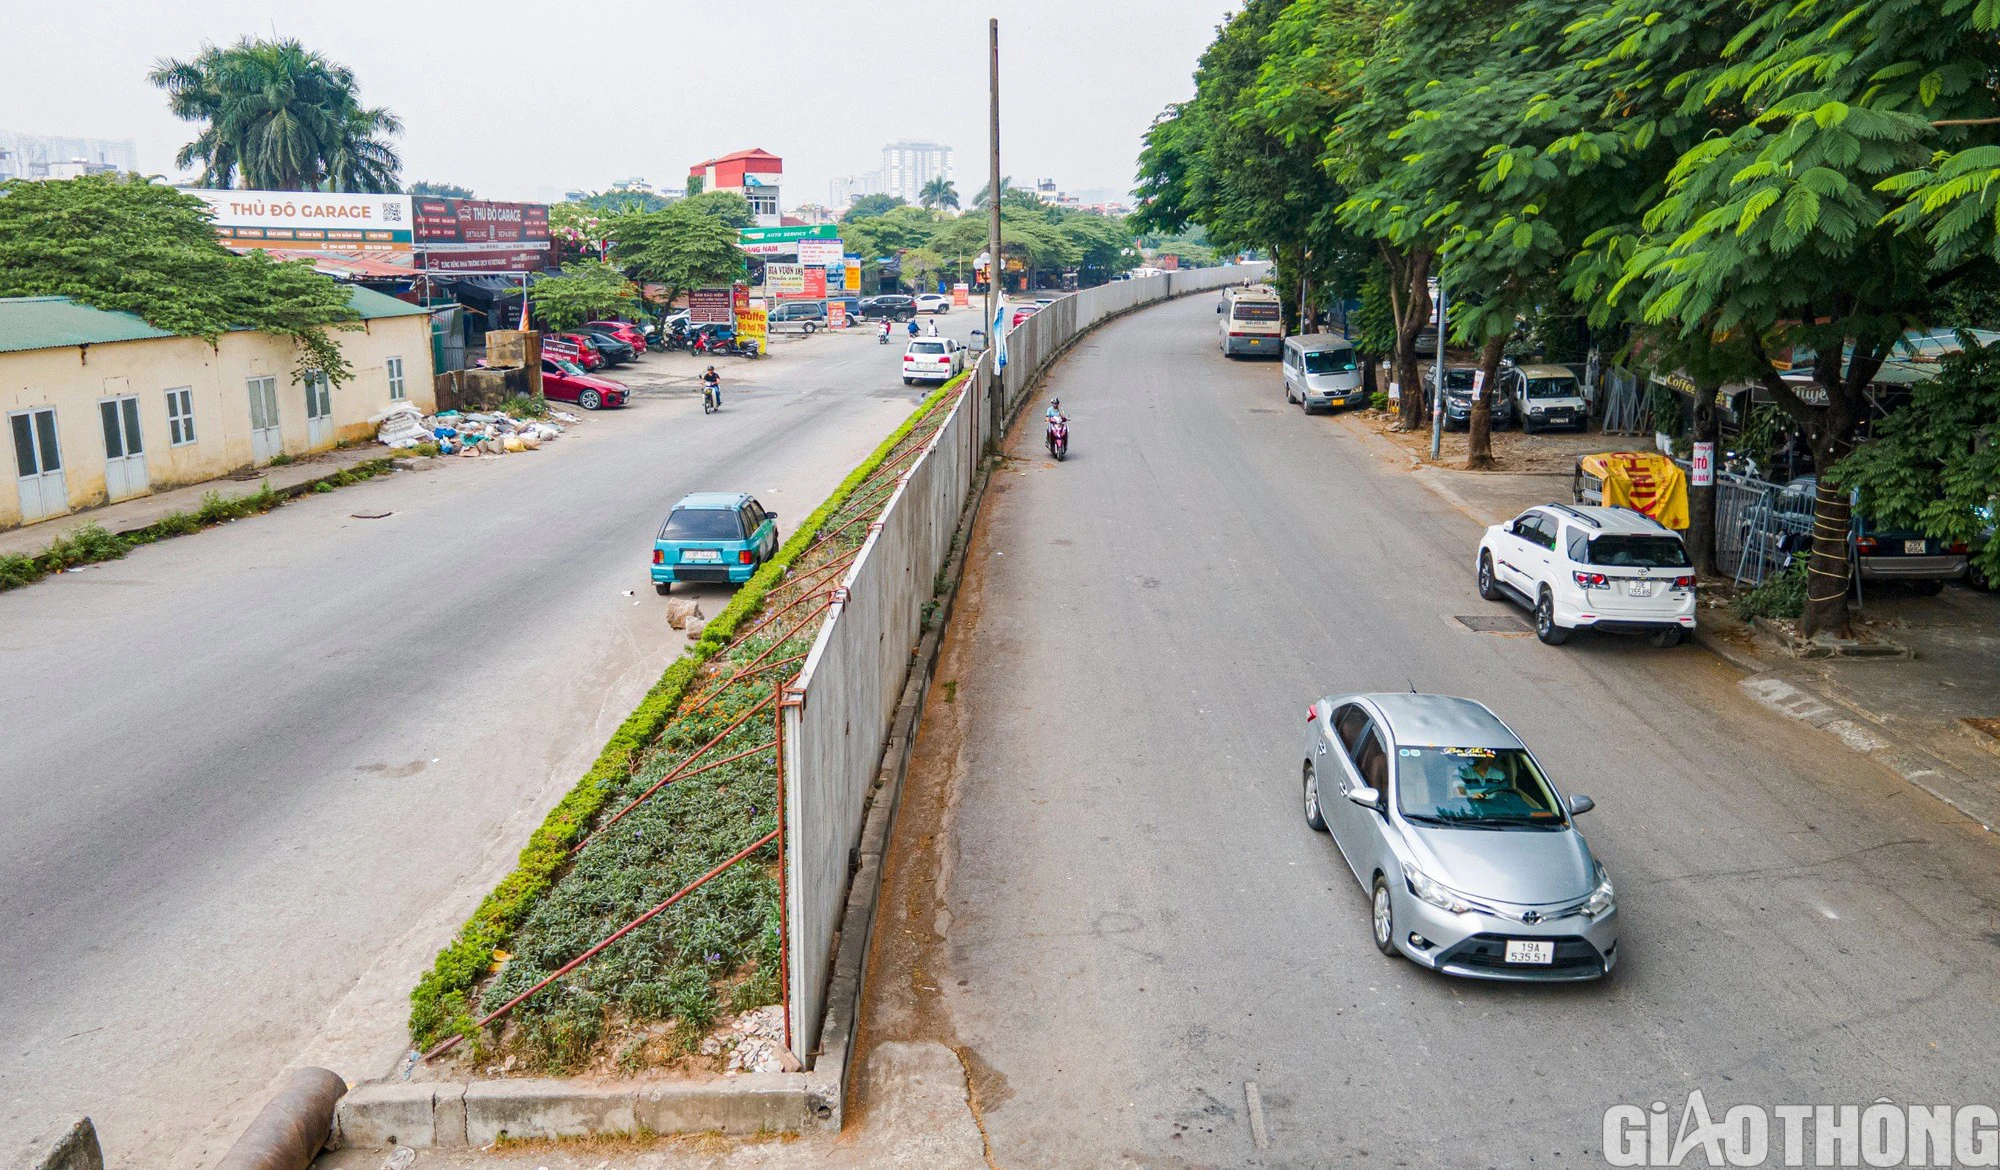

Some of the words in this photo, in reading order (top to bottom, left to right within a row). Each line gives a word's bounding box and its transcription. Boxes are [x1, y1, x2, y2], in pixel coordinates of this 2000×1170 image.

[230, 199, 265, 216] THỦ
[269, 201, 296, 217] ĐÔ
[301, 205, 372, 218] GARAGE
[473, 203, 486, 221] THỦ
[487, 204, 497, 221] ĐÔ
[497, 209, 521, 222] GARAGE
[768, 265, 778, 275] BIA
[1667, 374, 1696, 395] Coffee
[1522, 943, 1540, 952] 19A
[1511, 952, 1546, 962] 535.51
